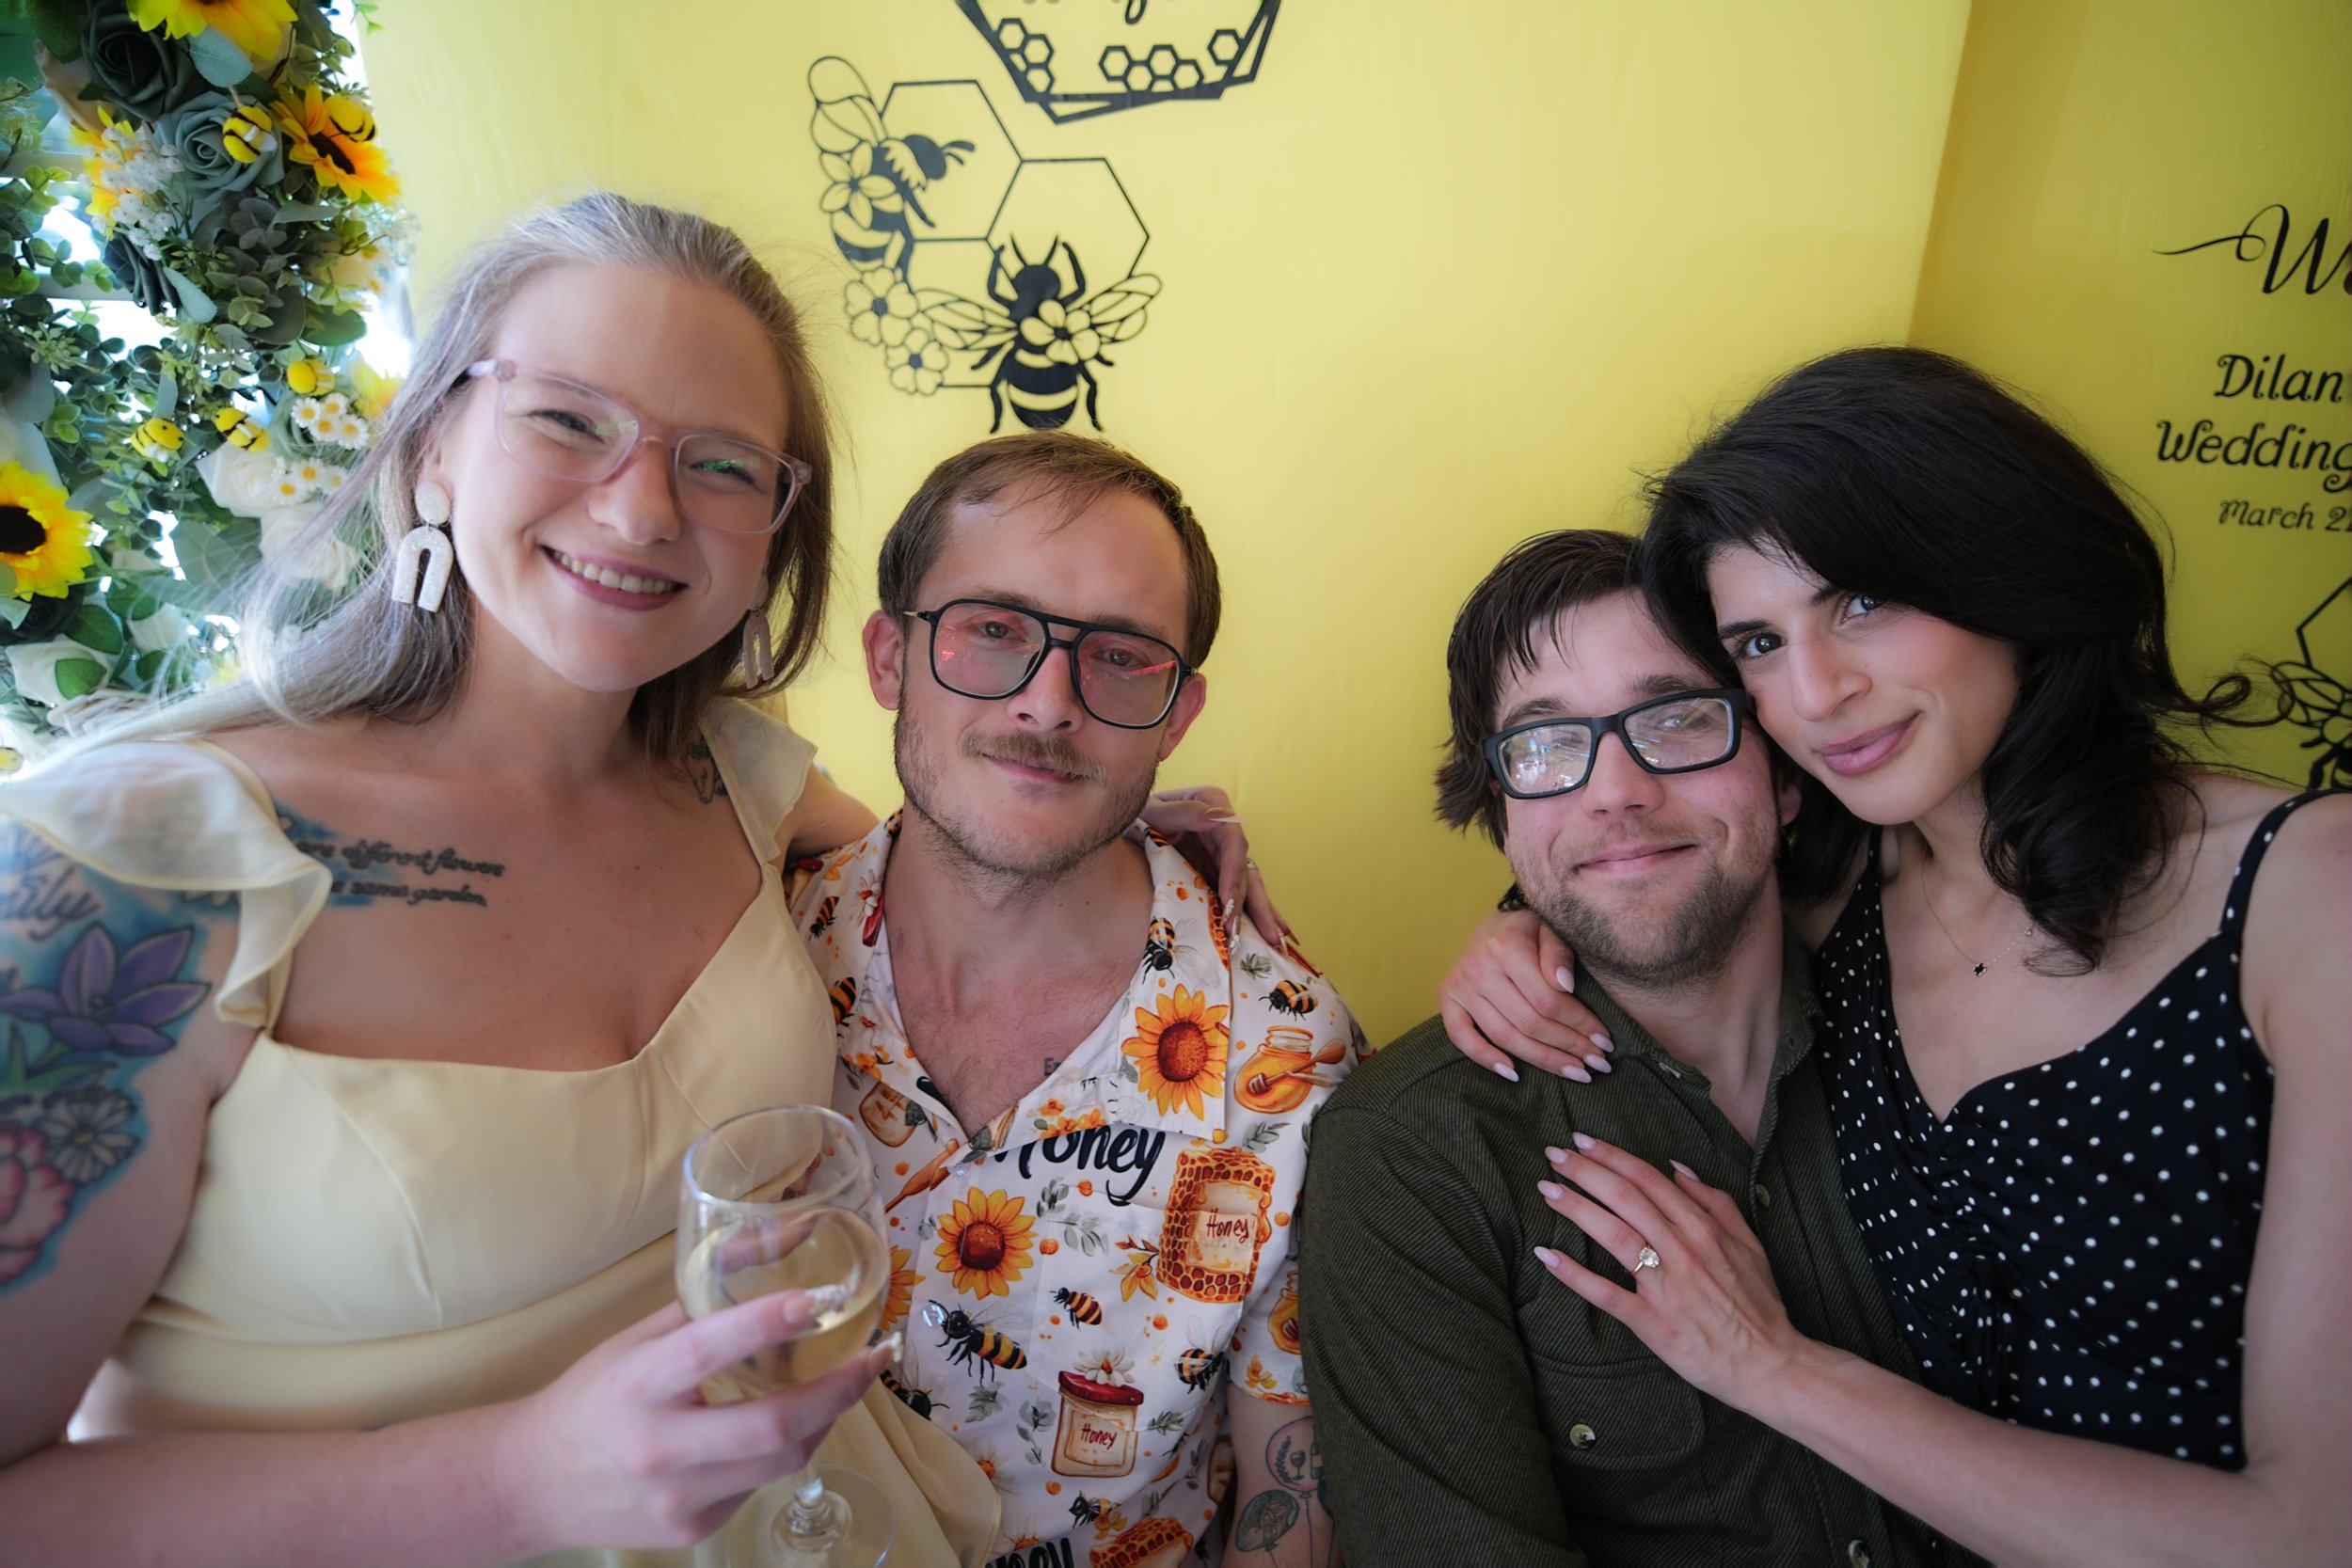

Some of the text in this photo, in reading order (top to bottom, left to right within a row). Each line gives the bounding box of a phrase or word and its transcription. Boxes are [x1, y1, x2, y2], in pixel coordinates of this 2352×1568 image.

[2214, 353, 2344, 403] Dilan
[2217, 499, 2314, 531] March
[1205, 1207, 1249, 1244] Honey
[1080, 1422, 1118, 1450] Honey
